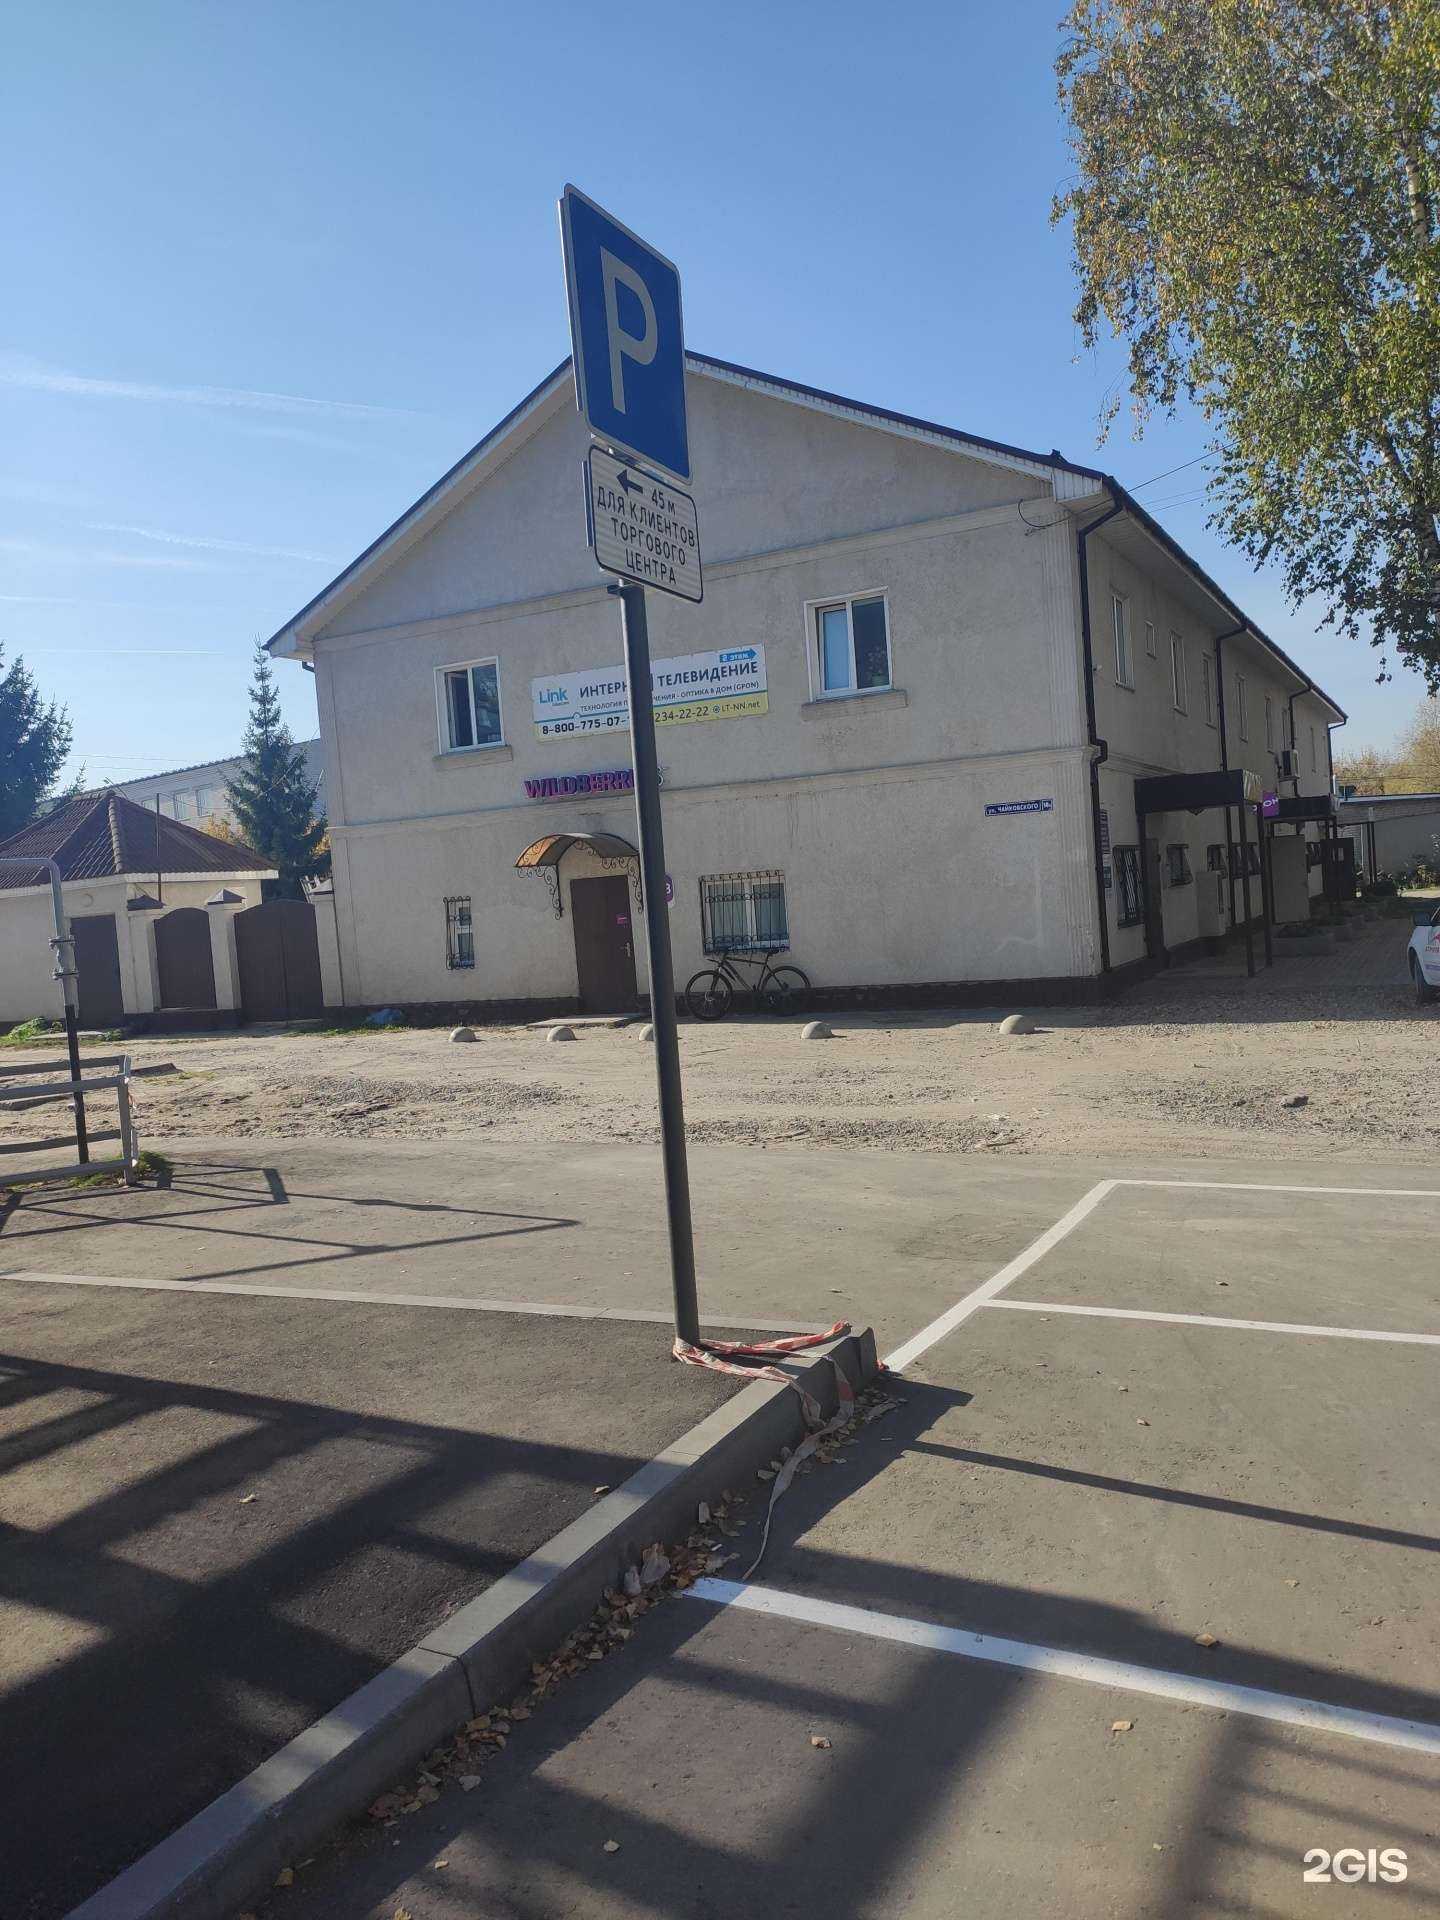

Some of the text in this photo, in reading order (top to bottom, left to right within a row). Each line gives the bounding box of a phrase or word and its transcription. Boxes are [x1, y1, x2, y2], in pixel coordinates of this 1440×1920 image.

[600, 245, 658, 415] P
[597, 486, 696, 547] ДЛЯ КЛИЕНТОВ
[651, 488, 665, 510] 45
[611, 517, 686, 566] ТОРГОВОГО
[625, 548, 677, 585] ЦЕНТРА
[539, 687, 569, 704] Link
[579, 680, 629, 698] ИНТЕРН
[657, 661, 759, 687] ТЕЛЕВИДЕНИЕ
[580, 701, 623, 712] ТЕХНОЛОГИЯ
[680, 688, 709, 699] ОПТИКА
[715, 685, 733, 695] ДОМ
[733, 680, 760, 692] (GPON)
[655, 705, 709, 723] 234-22-22
